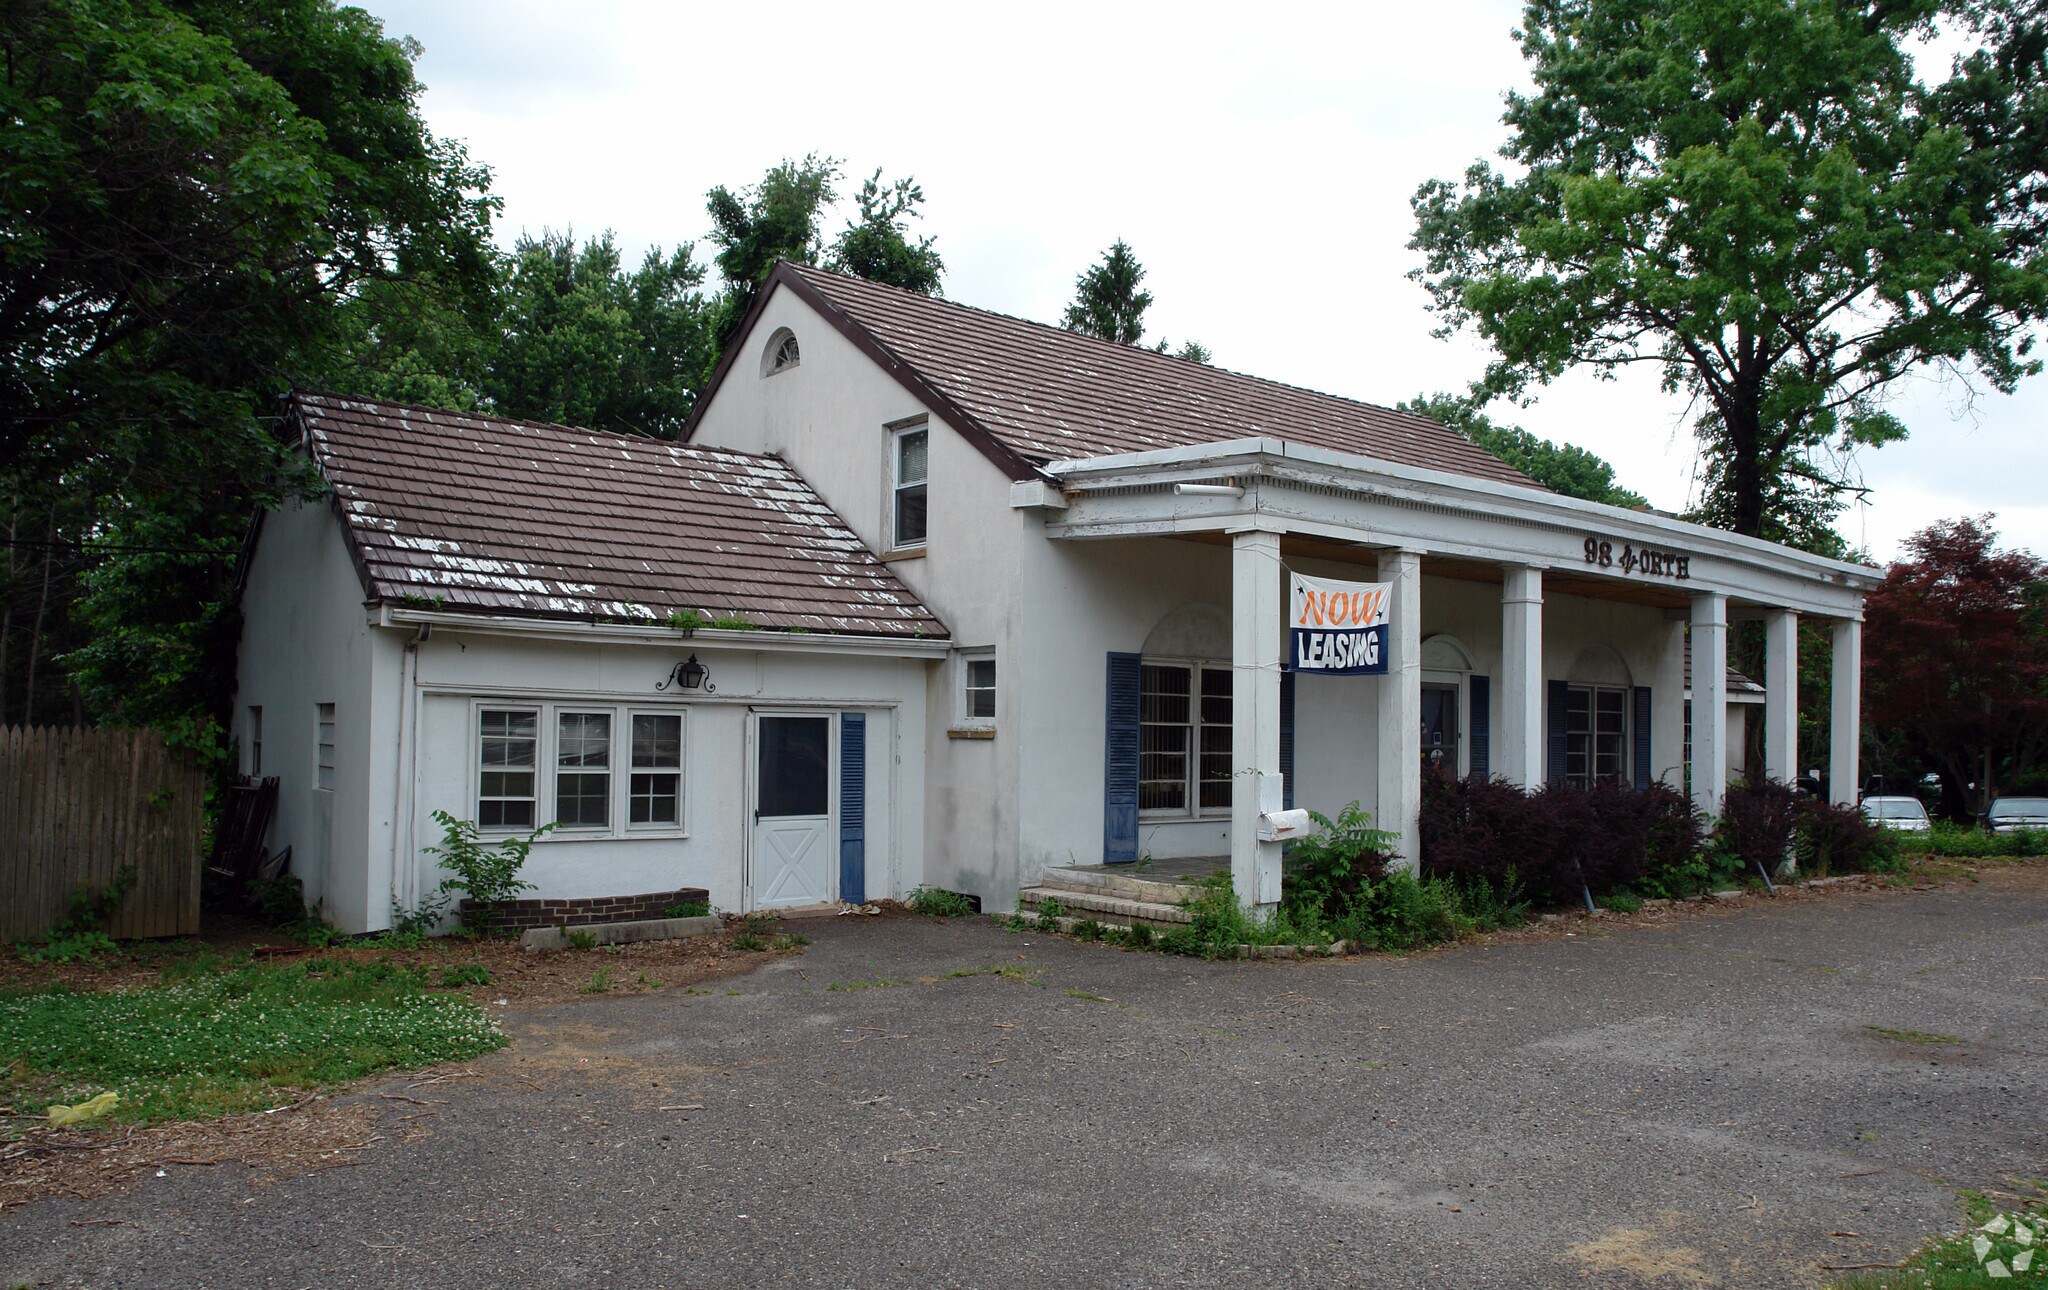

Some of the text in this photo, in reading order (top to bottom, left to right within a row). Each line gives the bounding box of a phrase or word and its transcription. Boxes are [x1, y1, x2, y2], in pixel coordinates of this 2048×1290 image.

[1584, 537, 1612, 567] 98
[1299, 589, 1382, 626] NOW
[1298, 630, 1379, 669] LEASING
